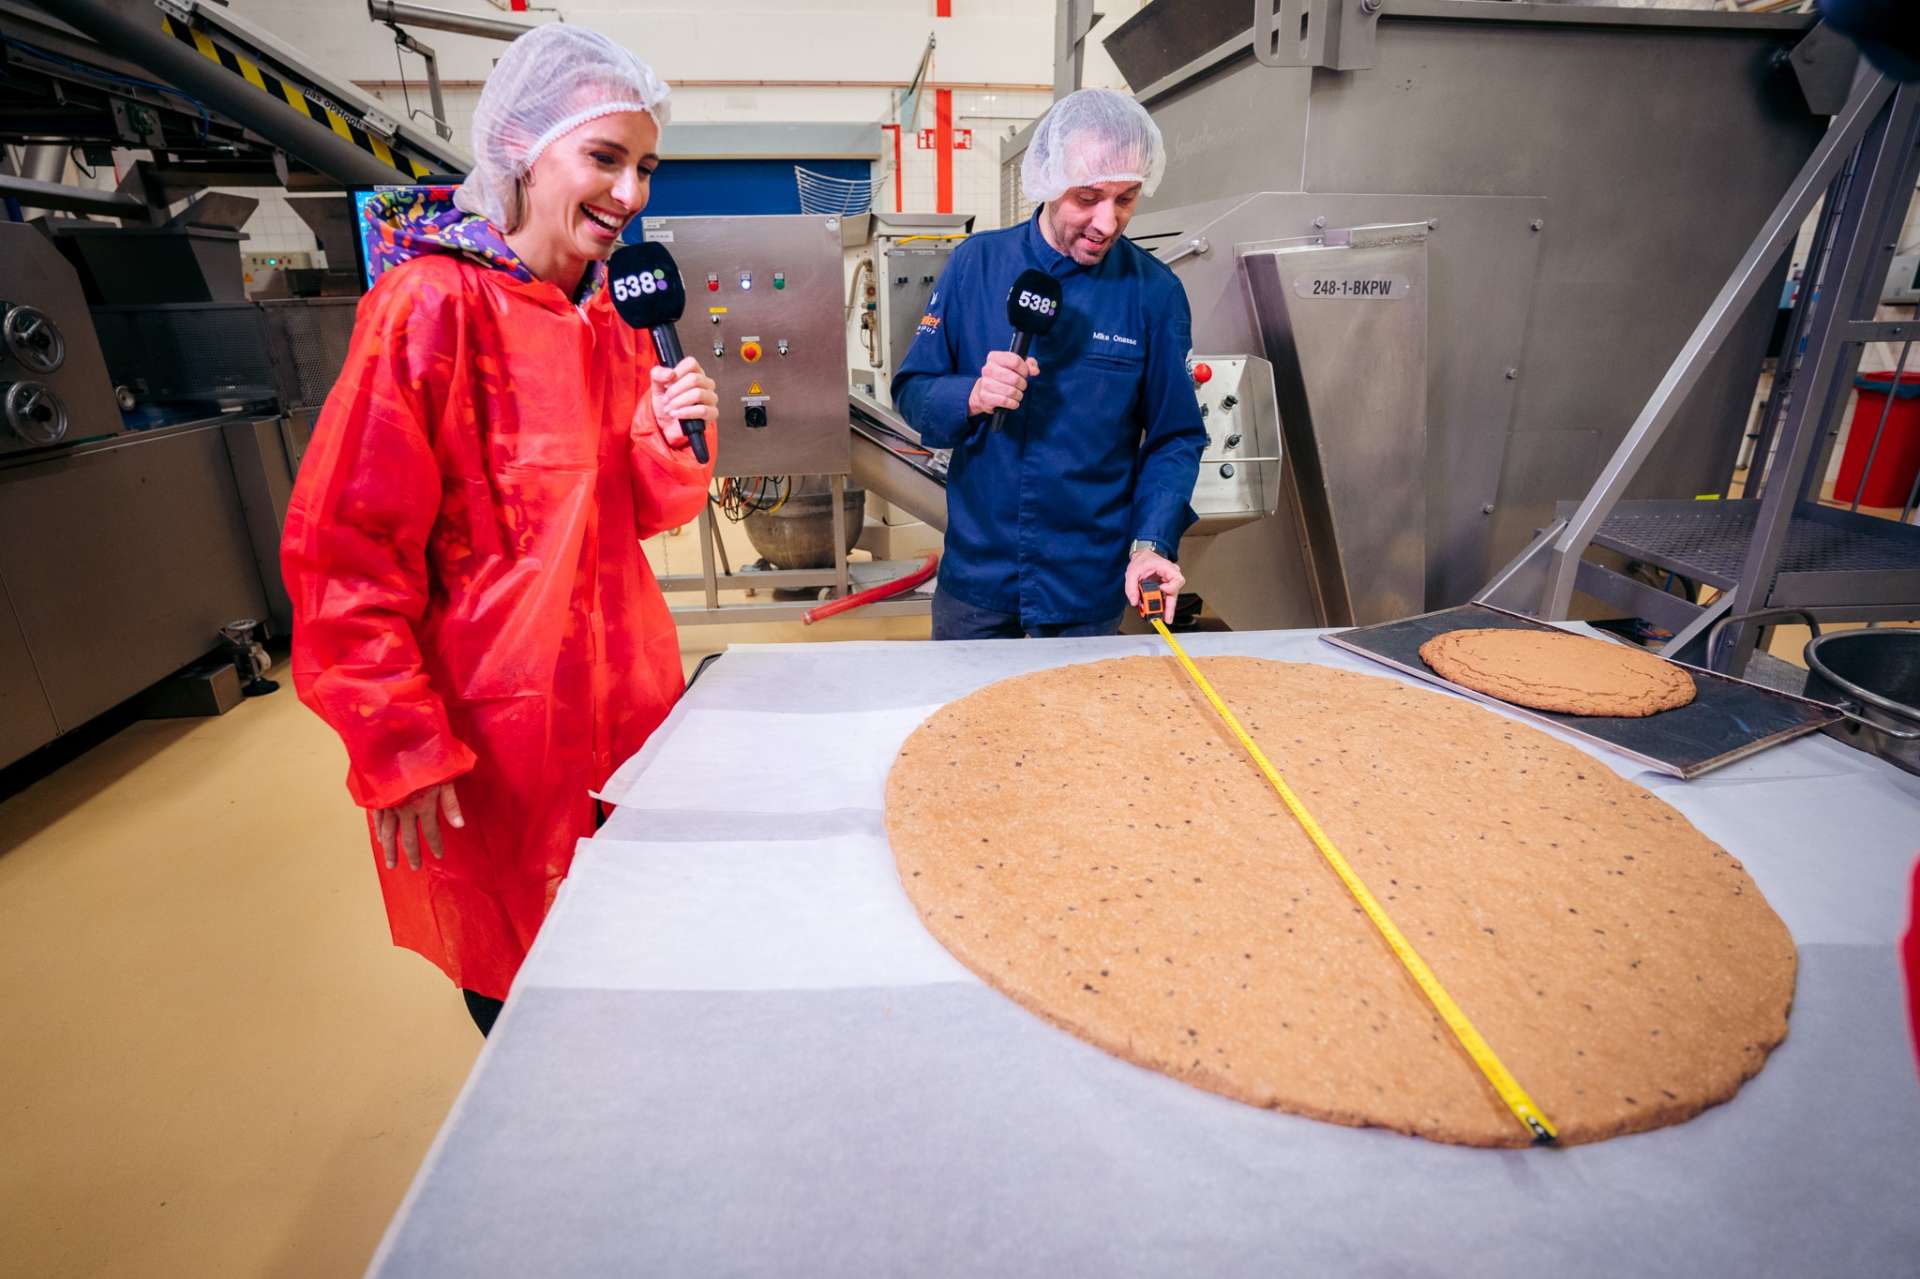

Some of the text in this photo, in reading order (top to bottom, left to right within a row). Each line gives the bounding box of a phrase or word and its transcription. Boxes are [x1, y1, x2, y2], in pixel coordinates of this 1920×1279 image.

[613, 271, 657, 302] 538
[1312, 279, 1393, 296] 248-1-BKPW
[1018, 290, 1051, 314] 538
